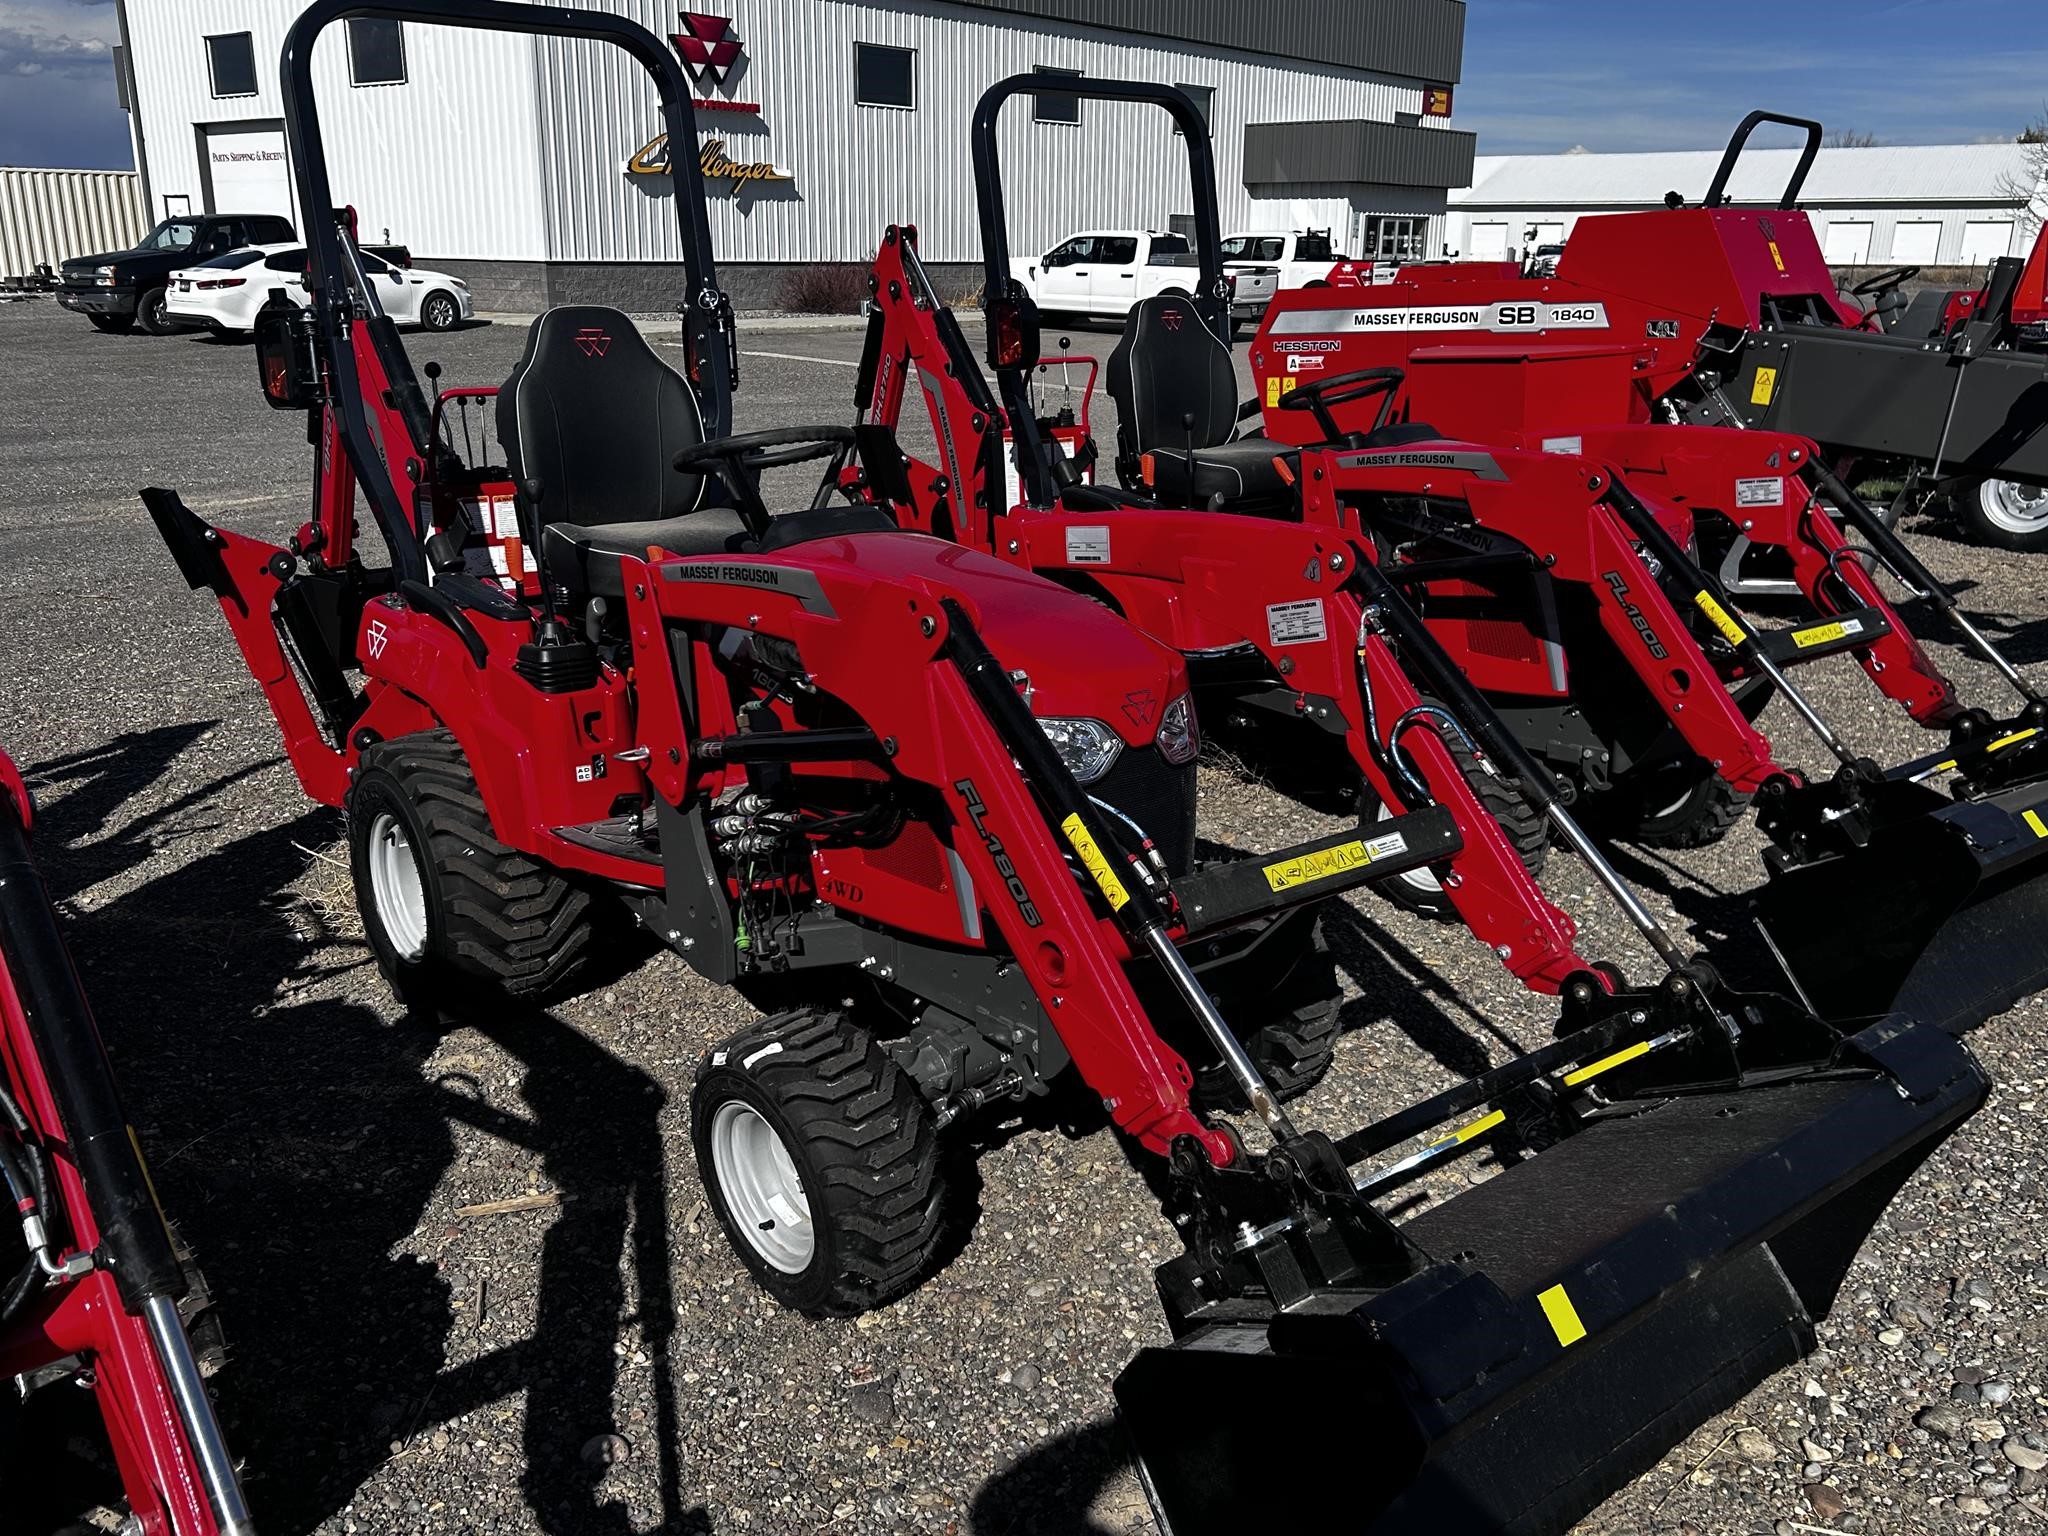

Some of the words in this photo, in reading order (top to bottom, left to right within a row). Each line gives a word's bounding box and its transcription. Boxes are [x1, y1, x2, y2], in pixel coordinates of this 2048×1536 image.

[628, 133, 795, 194] Cllenger
[1354, 313, 1405, 326] MASSEY
[1408, 311, 1479, 325] FERGUSON
[1498, 307, 1536, 325] SB
[1551, 309, 1595, 321] 1840
[1274, 341, 1340, 351] HESSTON
[1289, 358, 1297, 368] A
[1356, 455, 1397, 466] MASSEY
[1400, 455, 1455, 465] FERGUSON
[680, 566, 719, 579] MASSEY
[723, 567, 779, 585] FERGUSON
[1602, 570, 1669, 660] FL.1805
[954, 777, 1043, 928] FL.1805
